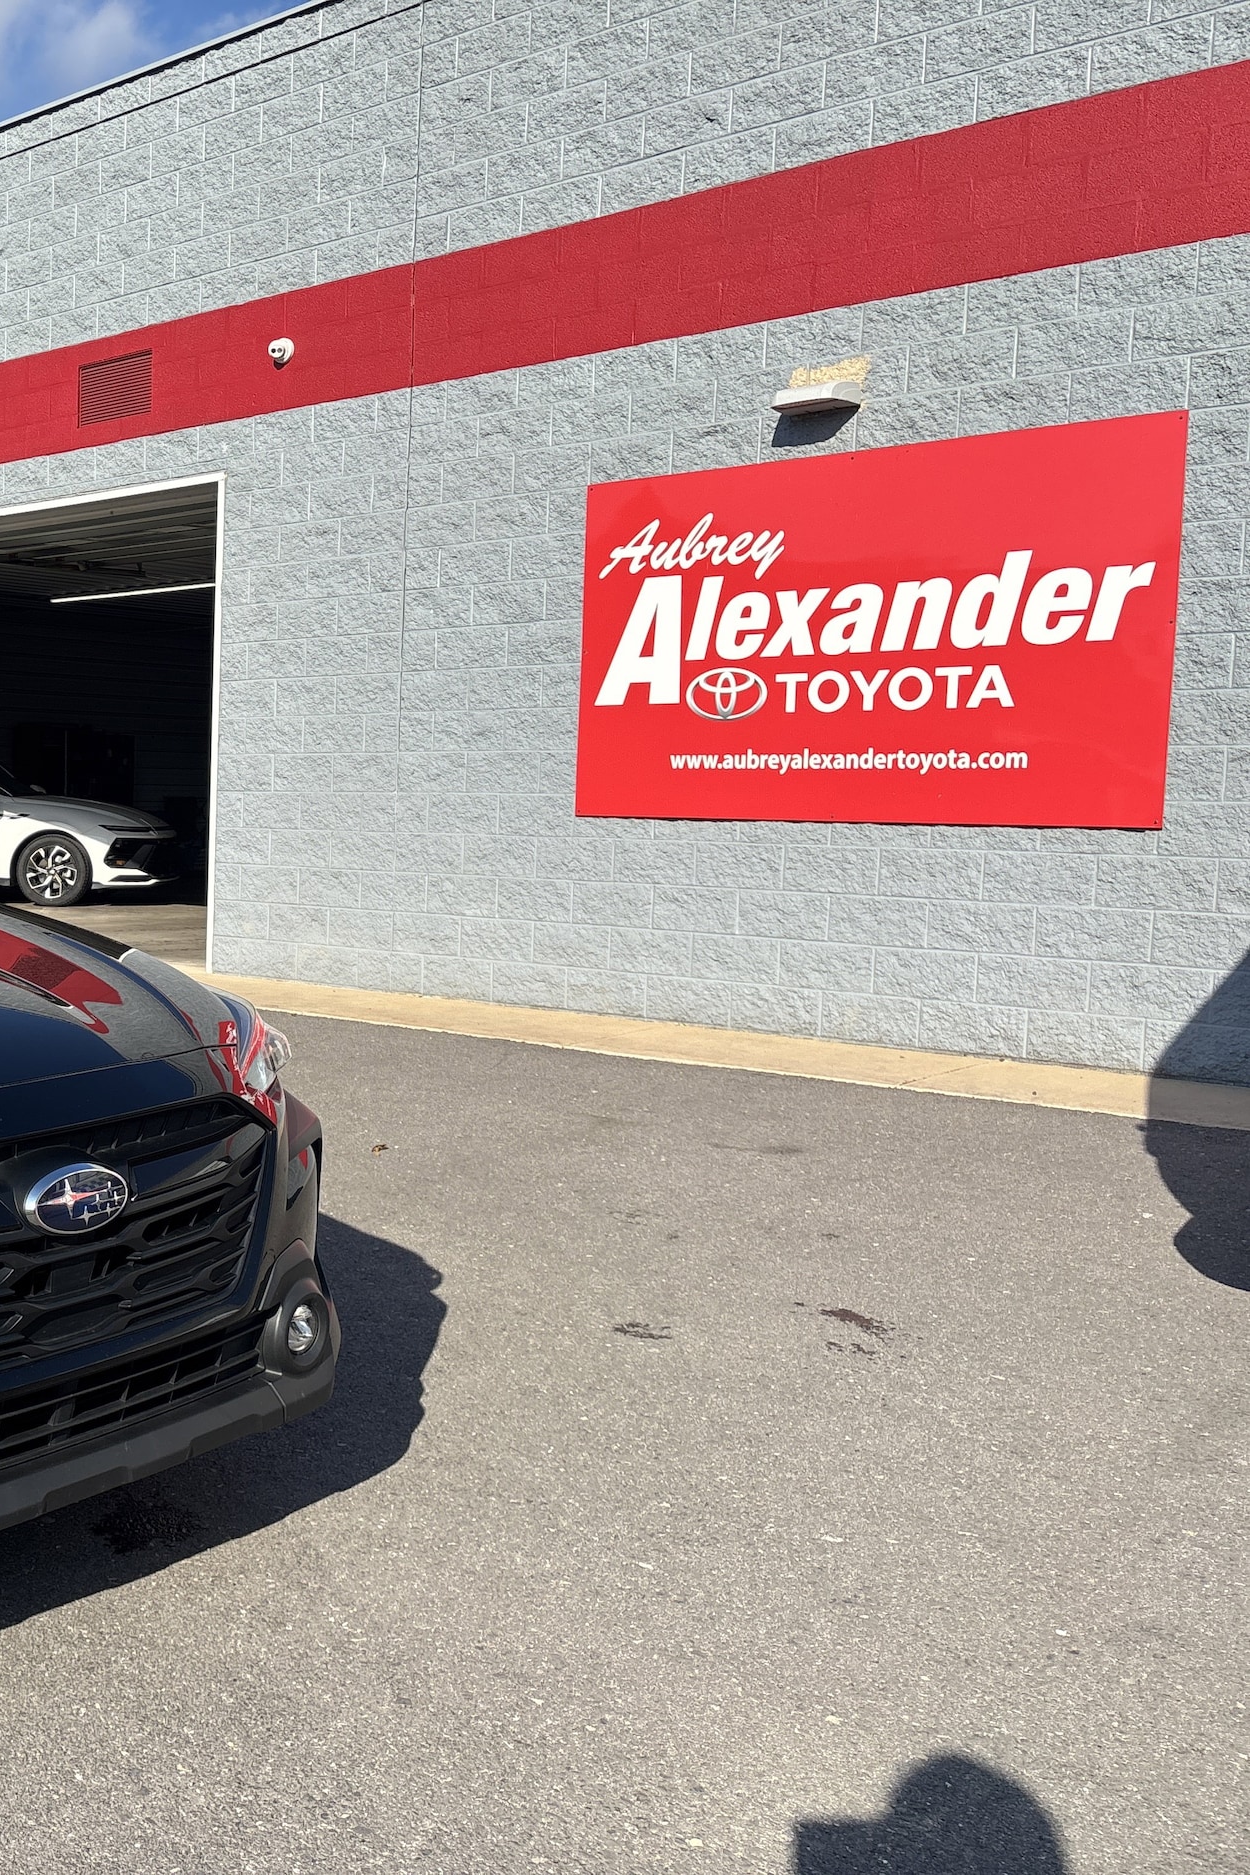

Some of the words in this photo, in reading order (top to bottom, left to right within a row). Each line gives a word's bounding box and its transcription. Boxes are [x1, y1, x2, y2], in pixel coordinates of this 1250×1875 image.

[599, 513, 785, 580] Aubrey
[595, 550, 1156, 706] Alexander
[776, 665, 1015, 713] TOYOTA
[670, 748, 1028, 775] www.aubreyalexandertoyota.com
